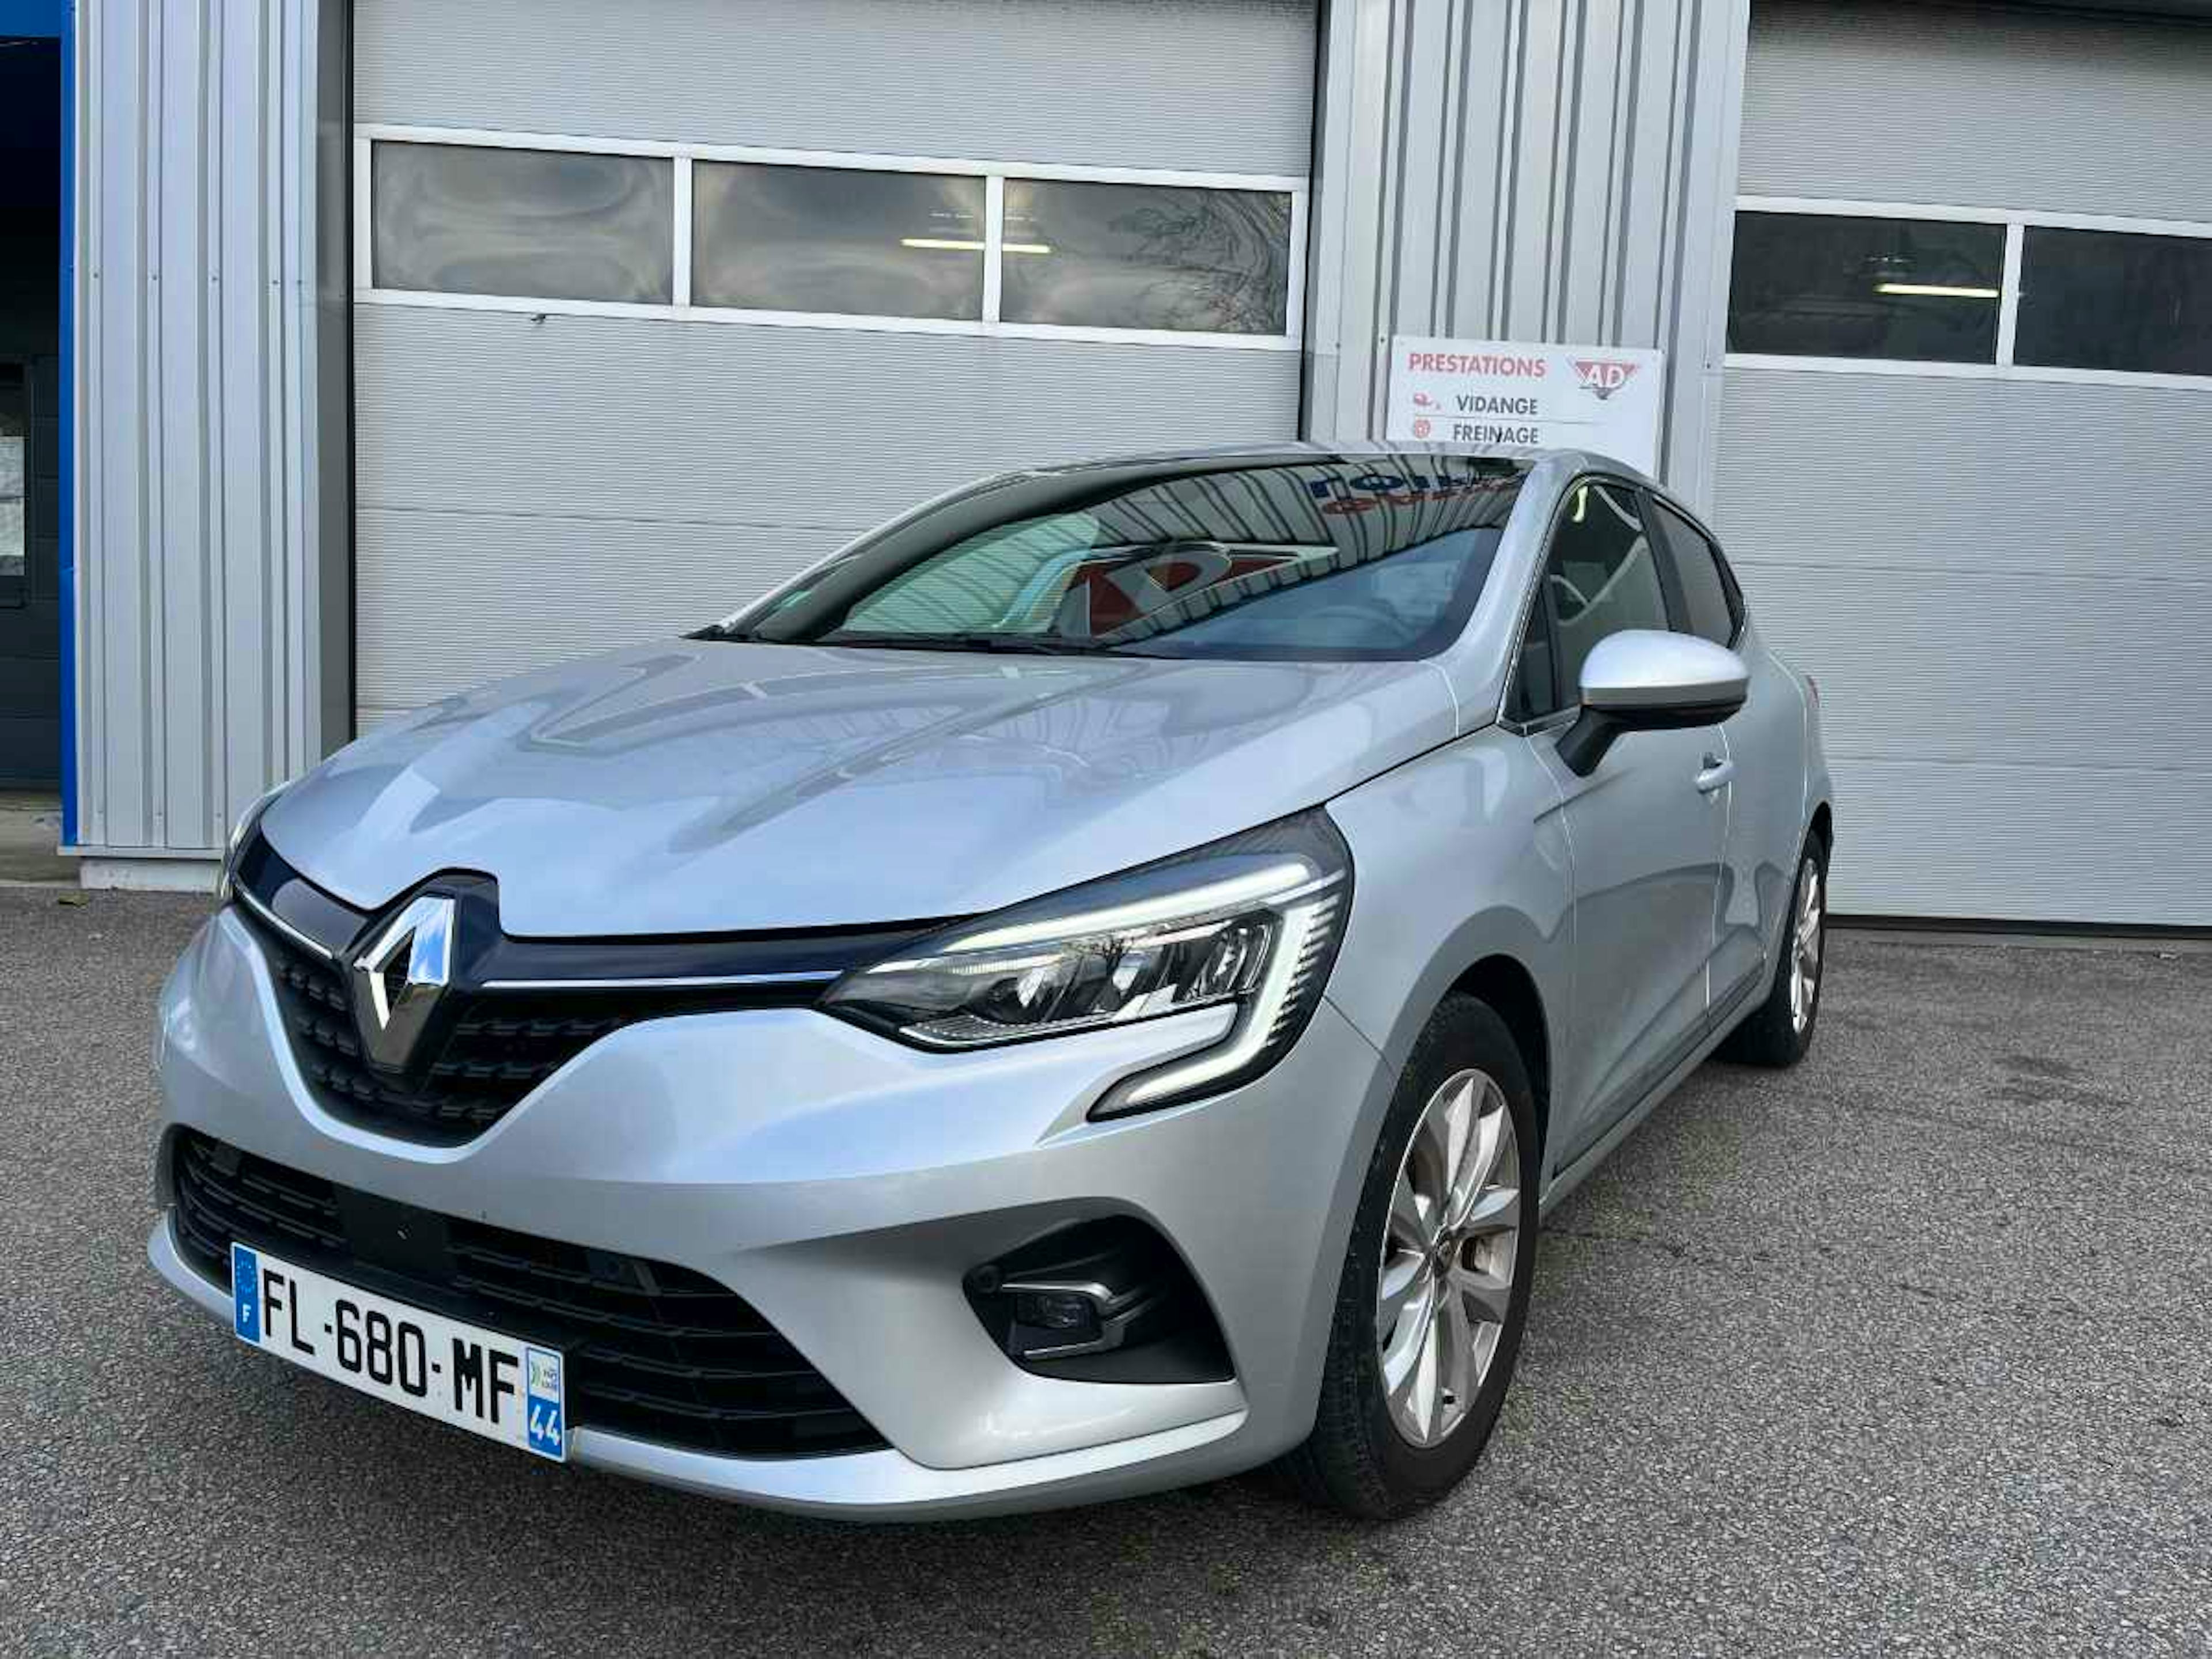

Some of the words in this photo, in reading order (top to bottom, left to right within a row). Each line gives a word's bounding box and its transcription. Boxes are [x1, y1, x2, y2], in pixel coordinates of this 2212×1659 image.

[1409, 353, 1546, 377] PRESTATIONS
[1582, 363, 1626, 388] AD
[1456, 394, 1539, 415] VIDANGE
[1453, 423, 1539, 444] FREINAGE
[242, 1304, 252, 1323] F
[263, 1268, 519, 1423] FL-680-MF
[529, 1403, 560, 1446] 44
